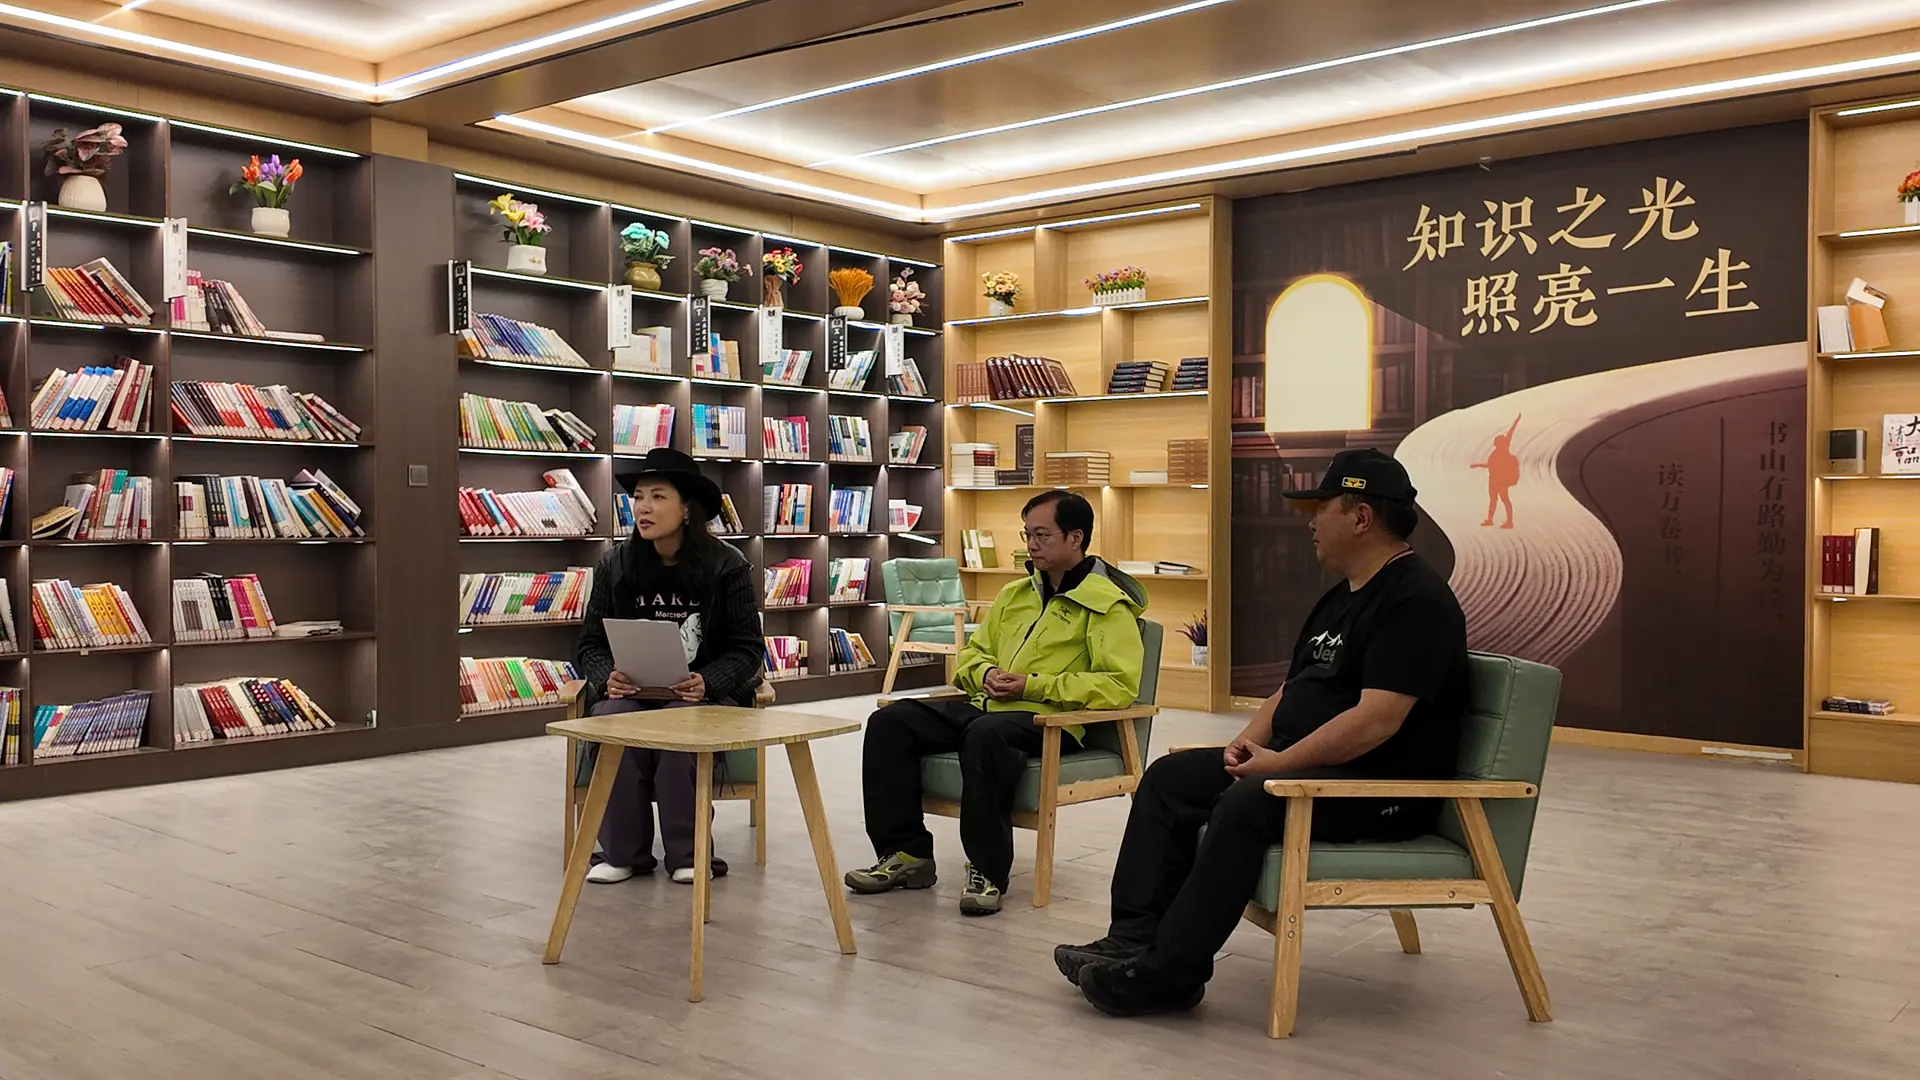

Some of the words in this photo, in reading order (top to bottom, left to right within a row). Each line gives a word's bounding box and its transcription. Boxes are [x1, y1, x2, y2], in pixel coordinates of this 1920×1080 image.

[1402, 176, 1700, 272] 知识之光
[1461, 248, 1760, 337] 照亮一生
